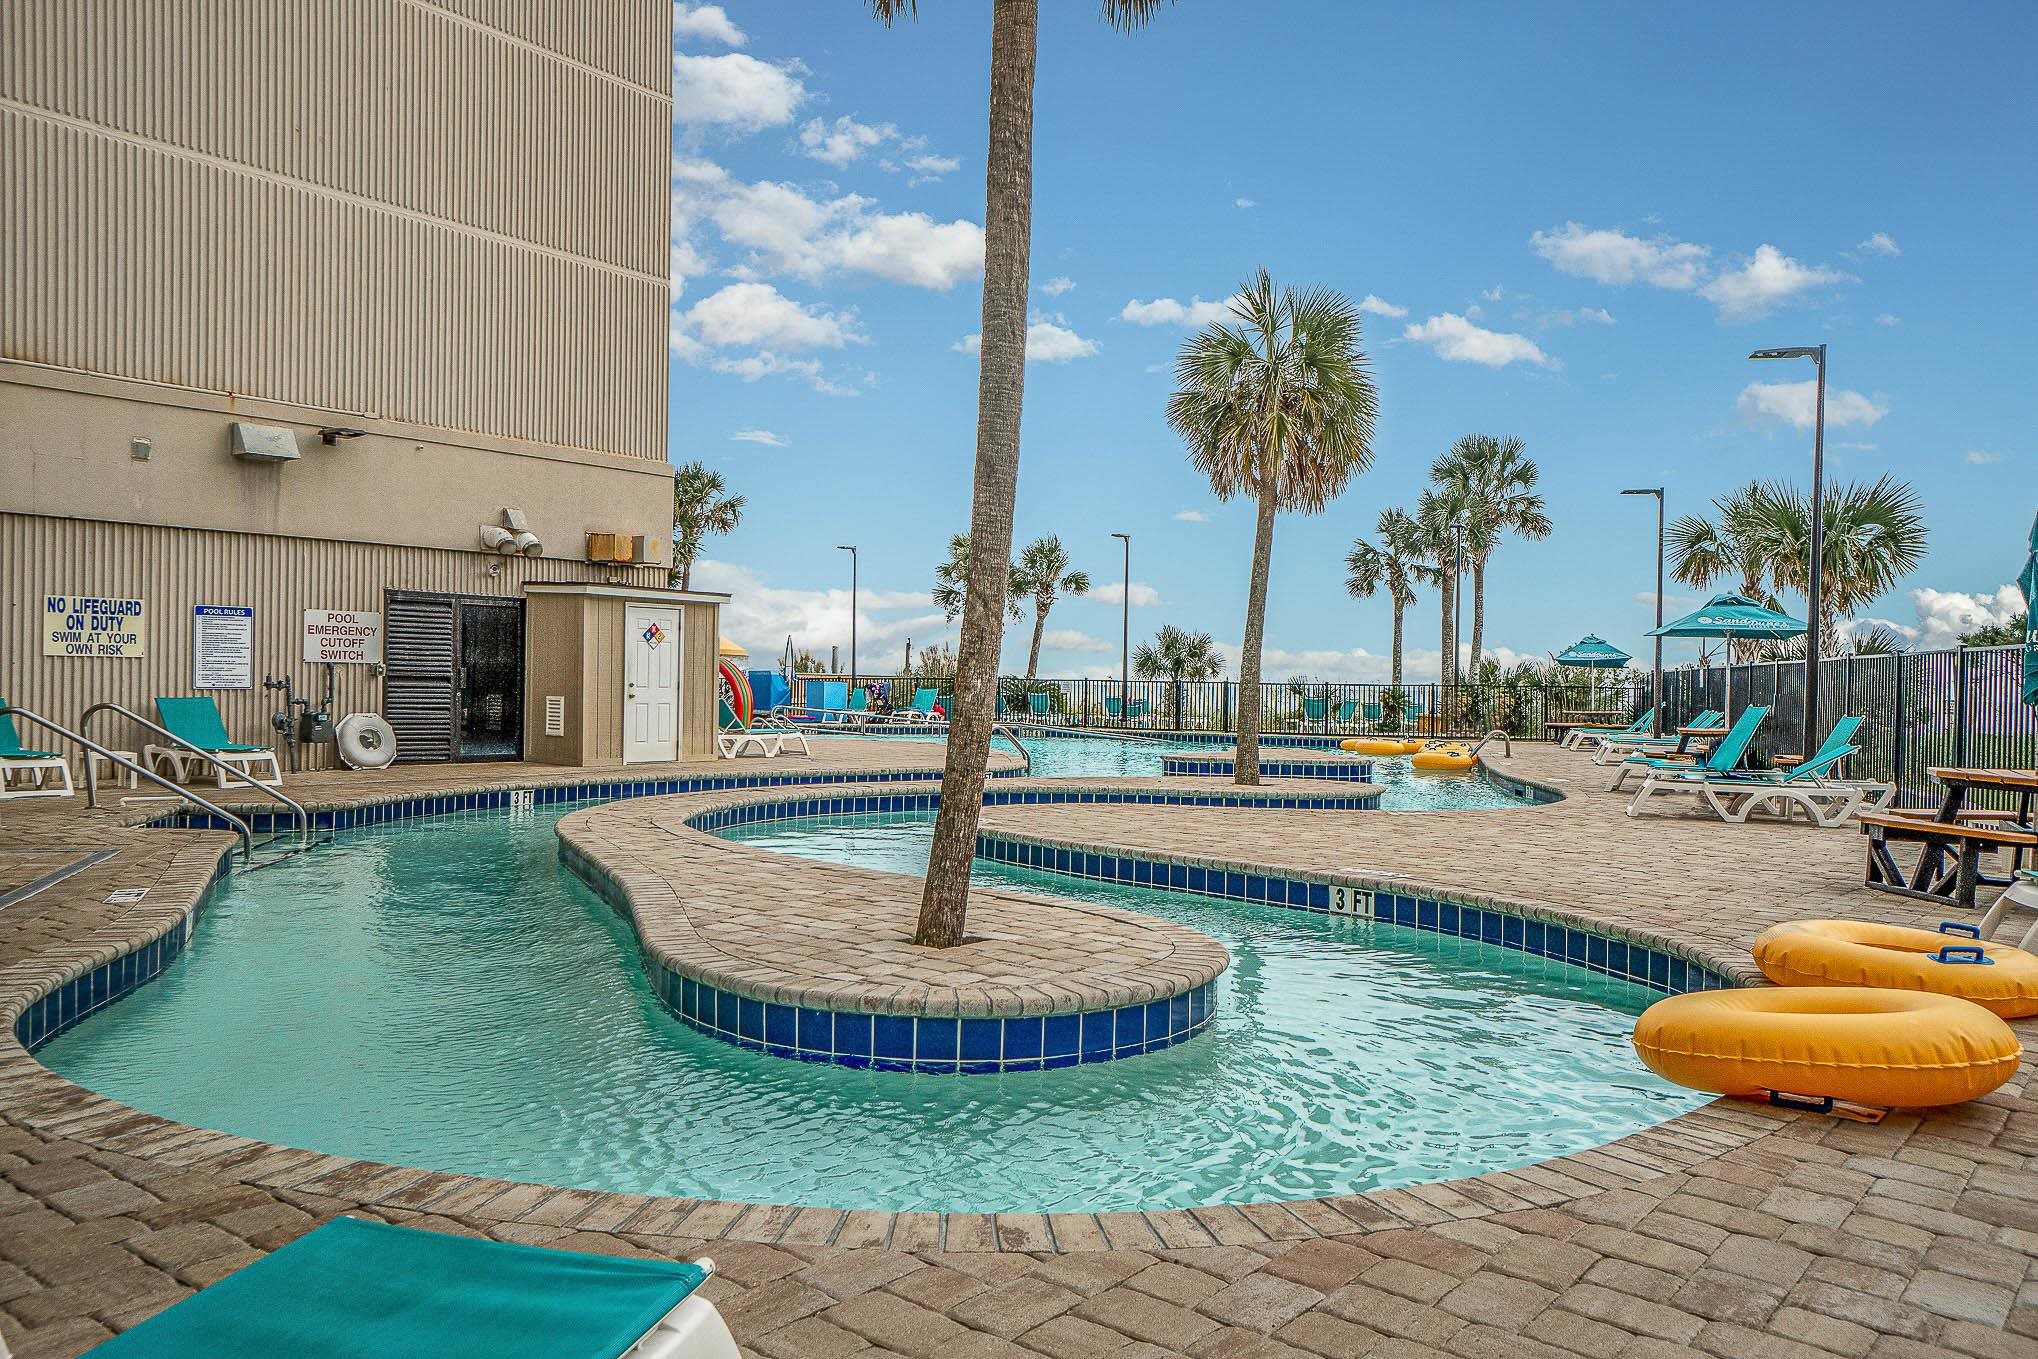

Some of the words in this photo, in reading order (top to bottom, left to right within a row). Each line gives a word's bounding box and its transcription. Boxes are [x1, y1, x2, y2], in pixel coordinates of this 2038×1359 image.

[47, 597, 66, 613] NO
[72, 598, 142, 616] LIFEGUARD
[66, 614, 84, 631] ON
[91, 615, 124, 632] DUTY
[327, 613, 359, 624] POOL
[307, 624, 377, 637] EMERGENCY
[52, 631, 82, 643] SWIM
[87, 632, 101, 644] AT
[107, 633, 137, 645] YOUR
[320, 637, 365, 648] CUTOFF
[66, 643, 92, 655] OWN
[98, 644, 123, 656] RISK
[320, 649, 364, 660] SWITCH
[514, 791, 520, 804] 3
[522, 790, 533, 804] FT
[1335, 887, 1345, 911] 3
[1353, 889, 1373, 914] FT
